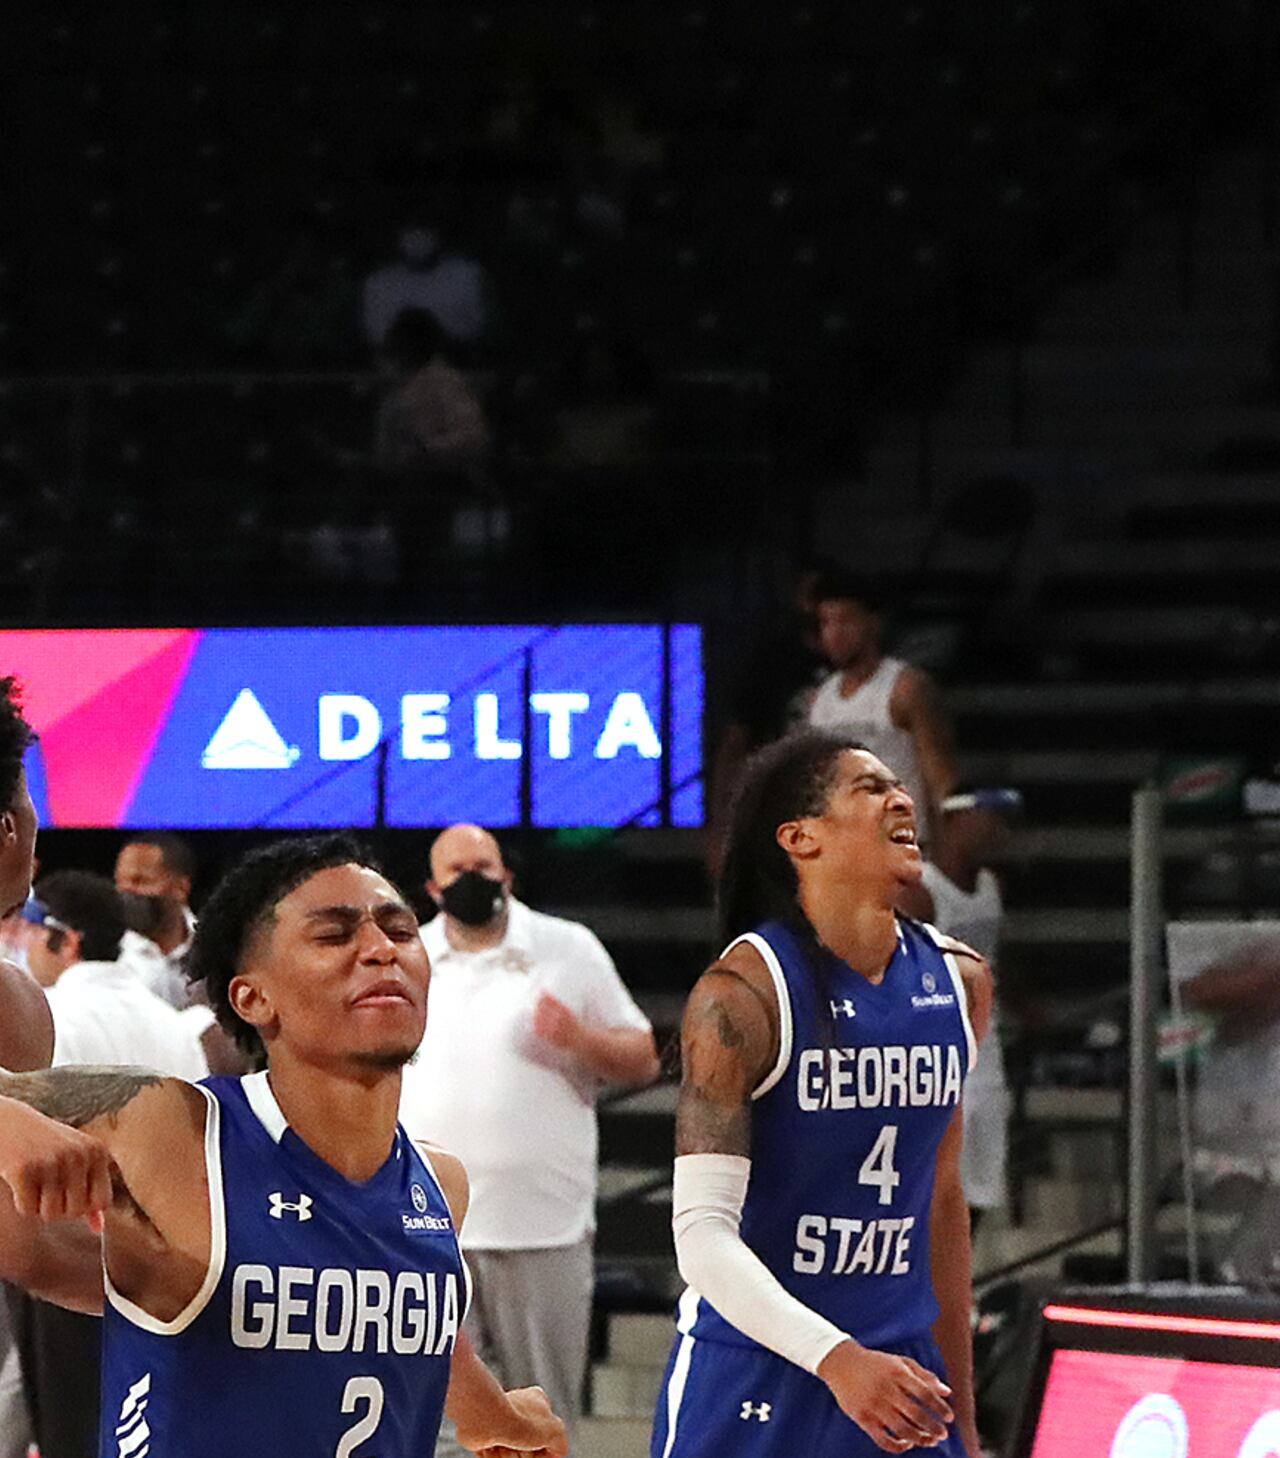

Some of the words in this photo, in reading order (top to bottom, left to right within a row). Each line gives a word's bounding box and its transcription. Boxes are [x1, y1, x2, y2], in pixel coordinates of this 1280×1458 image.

[317, 692, 662, 760] DELTA
[797, 1045, 961, 1112] GEORGIA
[858, 1124, 900, 1206] 4
[792, 1213, 916, 1276] STATE
[230, 1263, 459, 1356] GEORGIA
